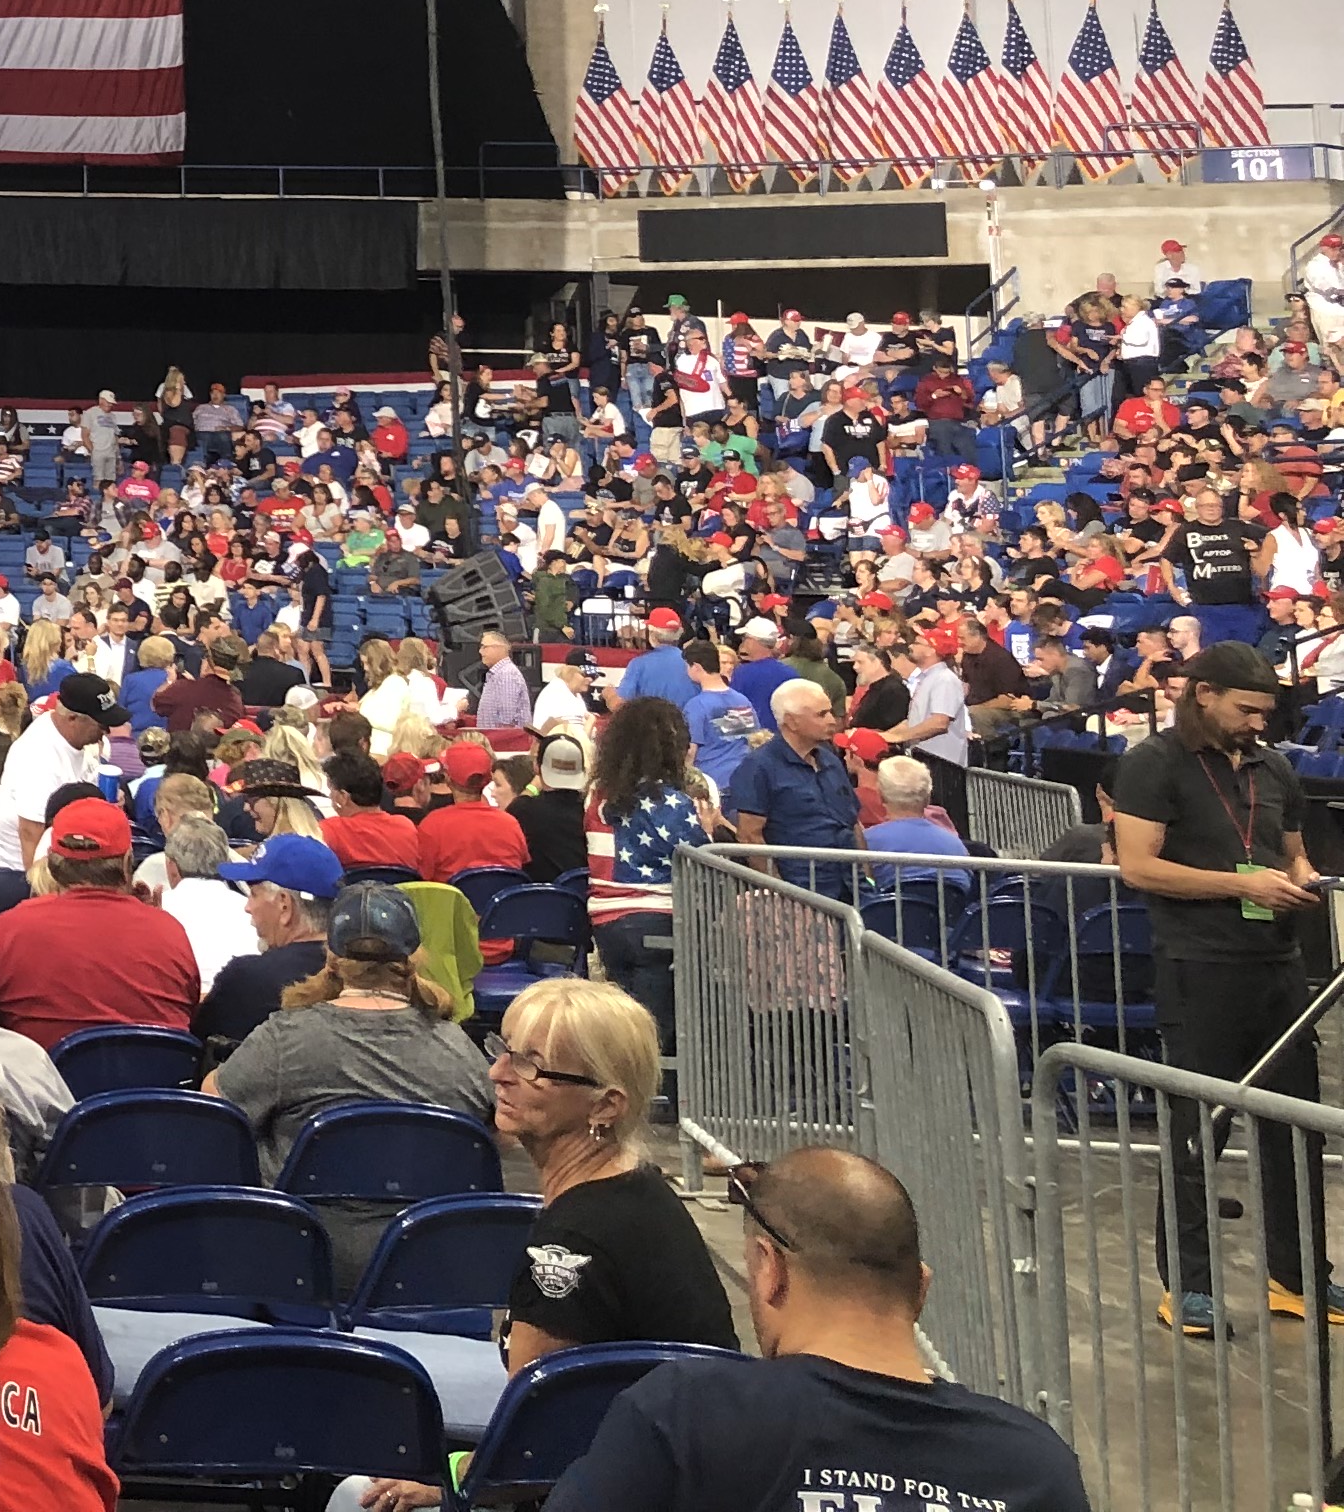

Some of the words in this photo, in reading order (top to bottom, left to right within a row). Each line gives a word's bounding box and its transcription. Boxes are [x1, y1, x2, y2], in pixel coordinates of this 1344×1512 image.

[1230, 149, 1280, 158] SECTION
[1231, 157, 1285, 181] 101
[803, 1468, 812, 1486] I
[819, 1468, 896, 1492] STAND
[903, 1477, 951, 1505] FOR
